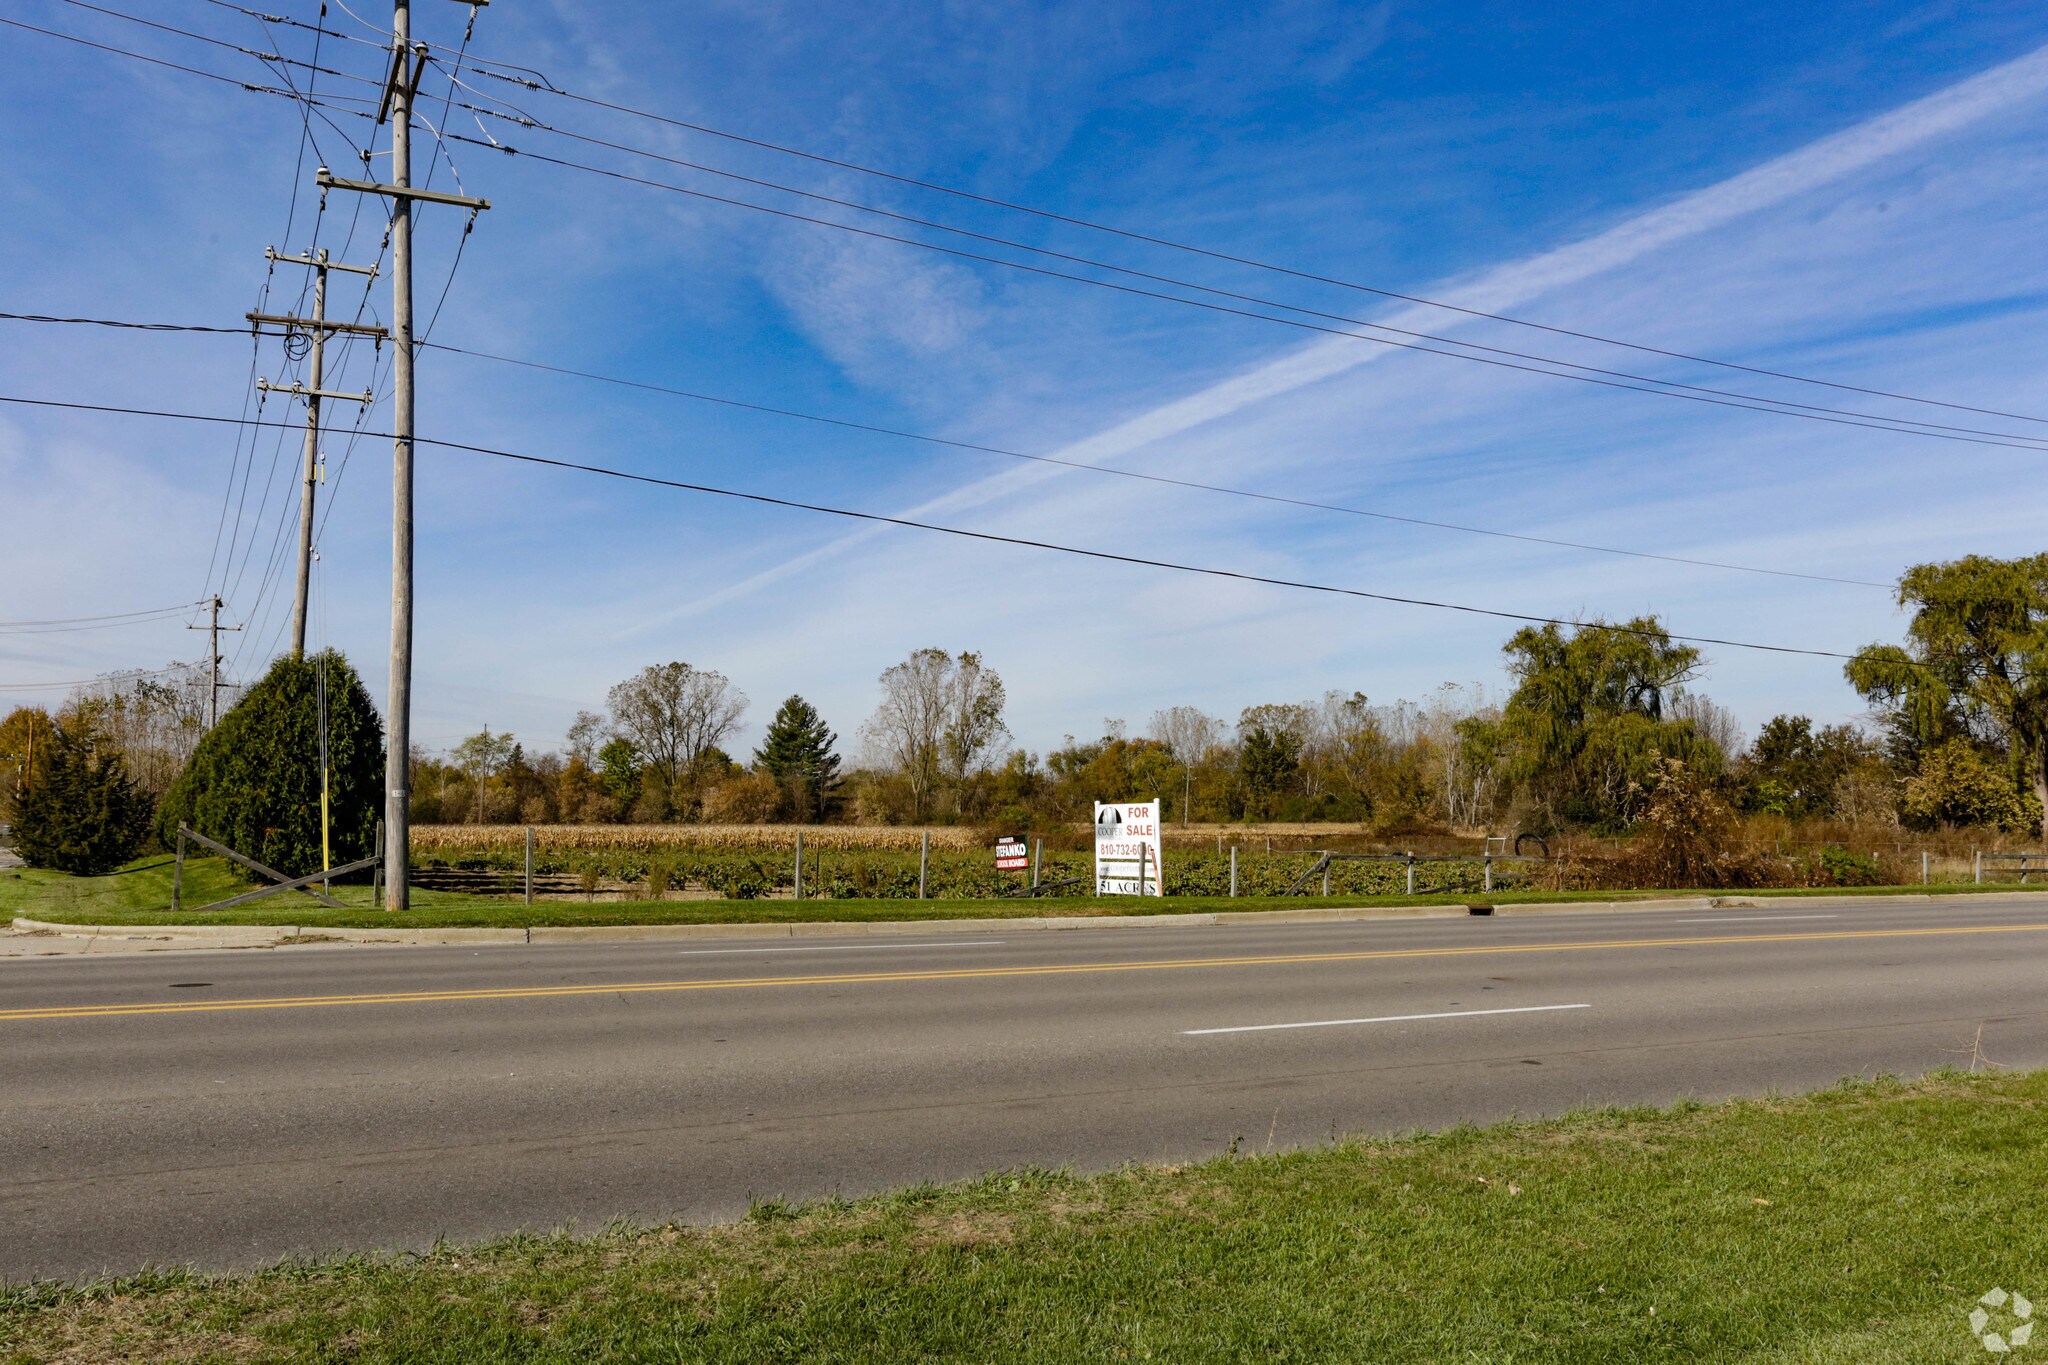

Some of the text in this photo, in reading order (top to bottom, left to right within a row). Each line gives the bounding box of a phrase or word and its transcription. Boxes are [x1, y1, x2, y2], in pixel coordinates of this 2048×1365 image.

[1128, 807, 1149, 818] FOR
[1098, 827, 1123, 836] COOPER
[1126, 825, 1153, 836] SALE
[996, 843, 1026, 857] STEFANKO
[1100, 844, 1153, 855] 810-732-600
[1100, 881, 1111, 891] 51
